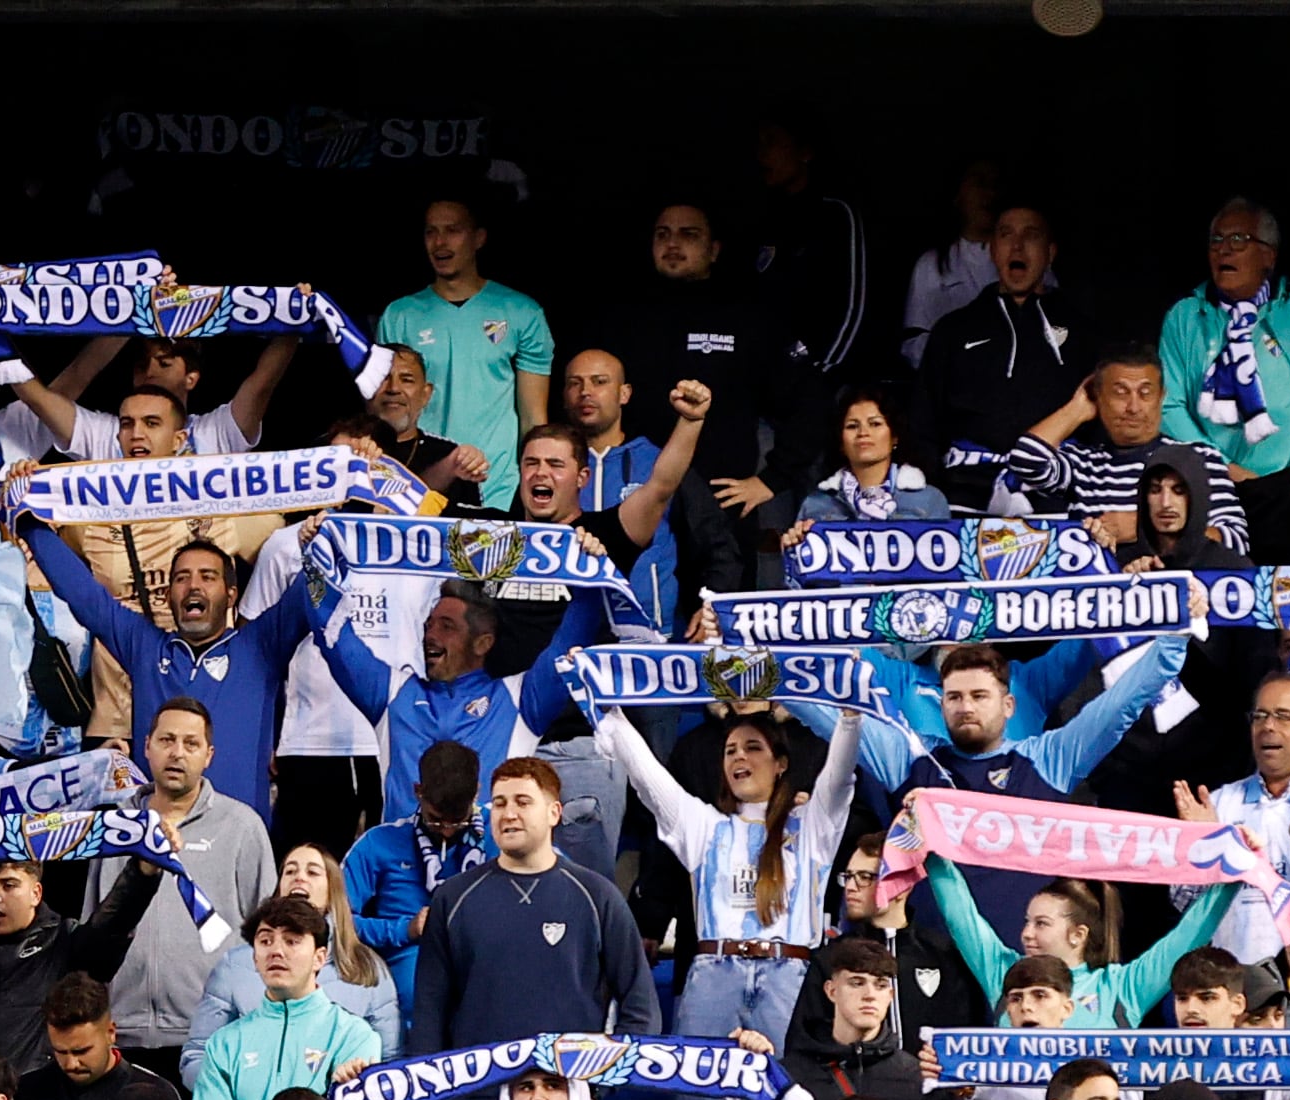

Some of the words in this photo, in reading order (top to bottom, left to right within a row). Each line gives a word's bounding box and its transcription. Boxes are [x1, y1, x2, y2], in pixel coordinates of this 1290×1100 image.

[109, 111, 282, 156] ONDO
[61, 458, 334, 507] INVENCIBLES
[799, 527, 961, 572] ONDO
[937, 799, 1181, 869] MALAGA
[637, 1043, 770, 1093] SUR
[945, 1035, 1013, 1057] MUY
[1019, 1035, 1112, 1058] NOBLE
[1122, 1035, 1139, 1057] Y
[1150, 1036, 1209, 1058] MUY
[955, 1060, 1055, 1084] CIUDA
[1139, 1059, 1284, 1085] MÁLAGA
